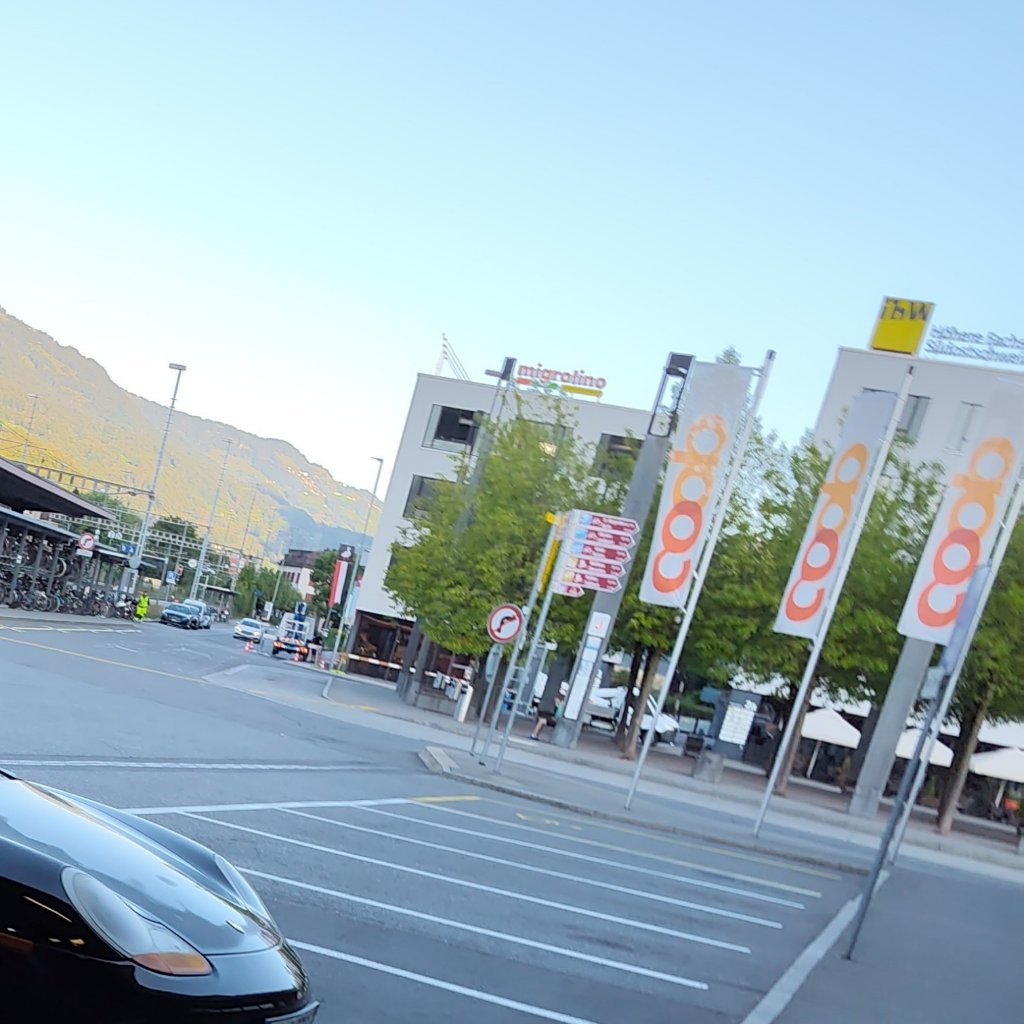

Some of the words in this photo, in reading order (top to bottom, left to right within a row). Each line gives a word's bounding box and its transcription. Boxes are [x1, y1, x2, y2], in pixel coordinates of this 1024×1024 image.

[518, 363, 607, 389] migrolino
[652, 413, 727, 593] coop
[785, 442, 869, 622] coop
[917, 436, 1015, 628] coop
